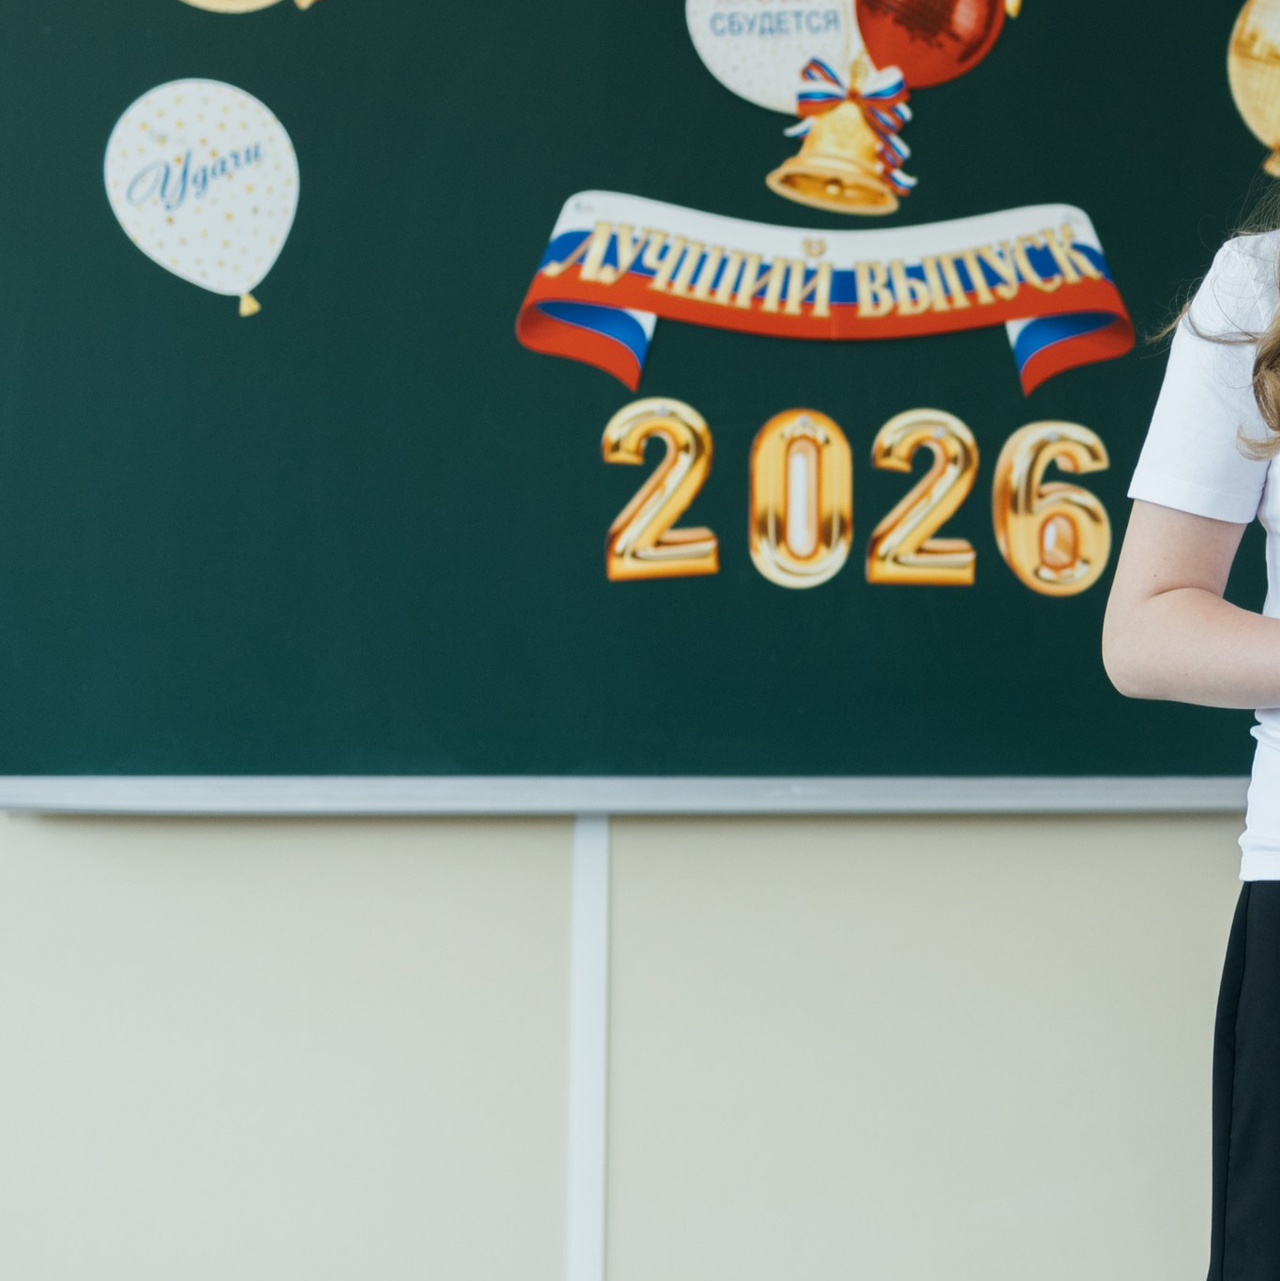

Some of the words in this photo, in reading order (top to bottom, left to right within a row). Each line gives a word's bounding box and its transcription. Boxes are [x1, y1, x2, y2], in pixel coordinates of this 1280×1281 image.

[709, 8, 840, 39] СБУДЕТСЯ
[543, 220, 834, 319] ЛУЧШИЙ
[854, 222, 1104, 319] ВЫПУСК
[601, 396, 1112, 597] 2026
